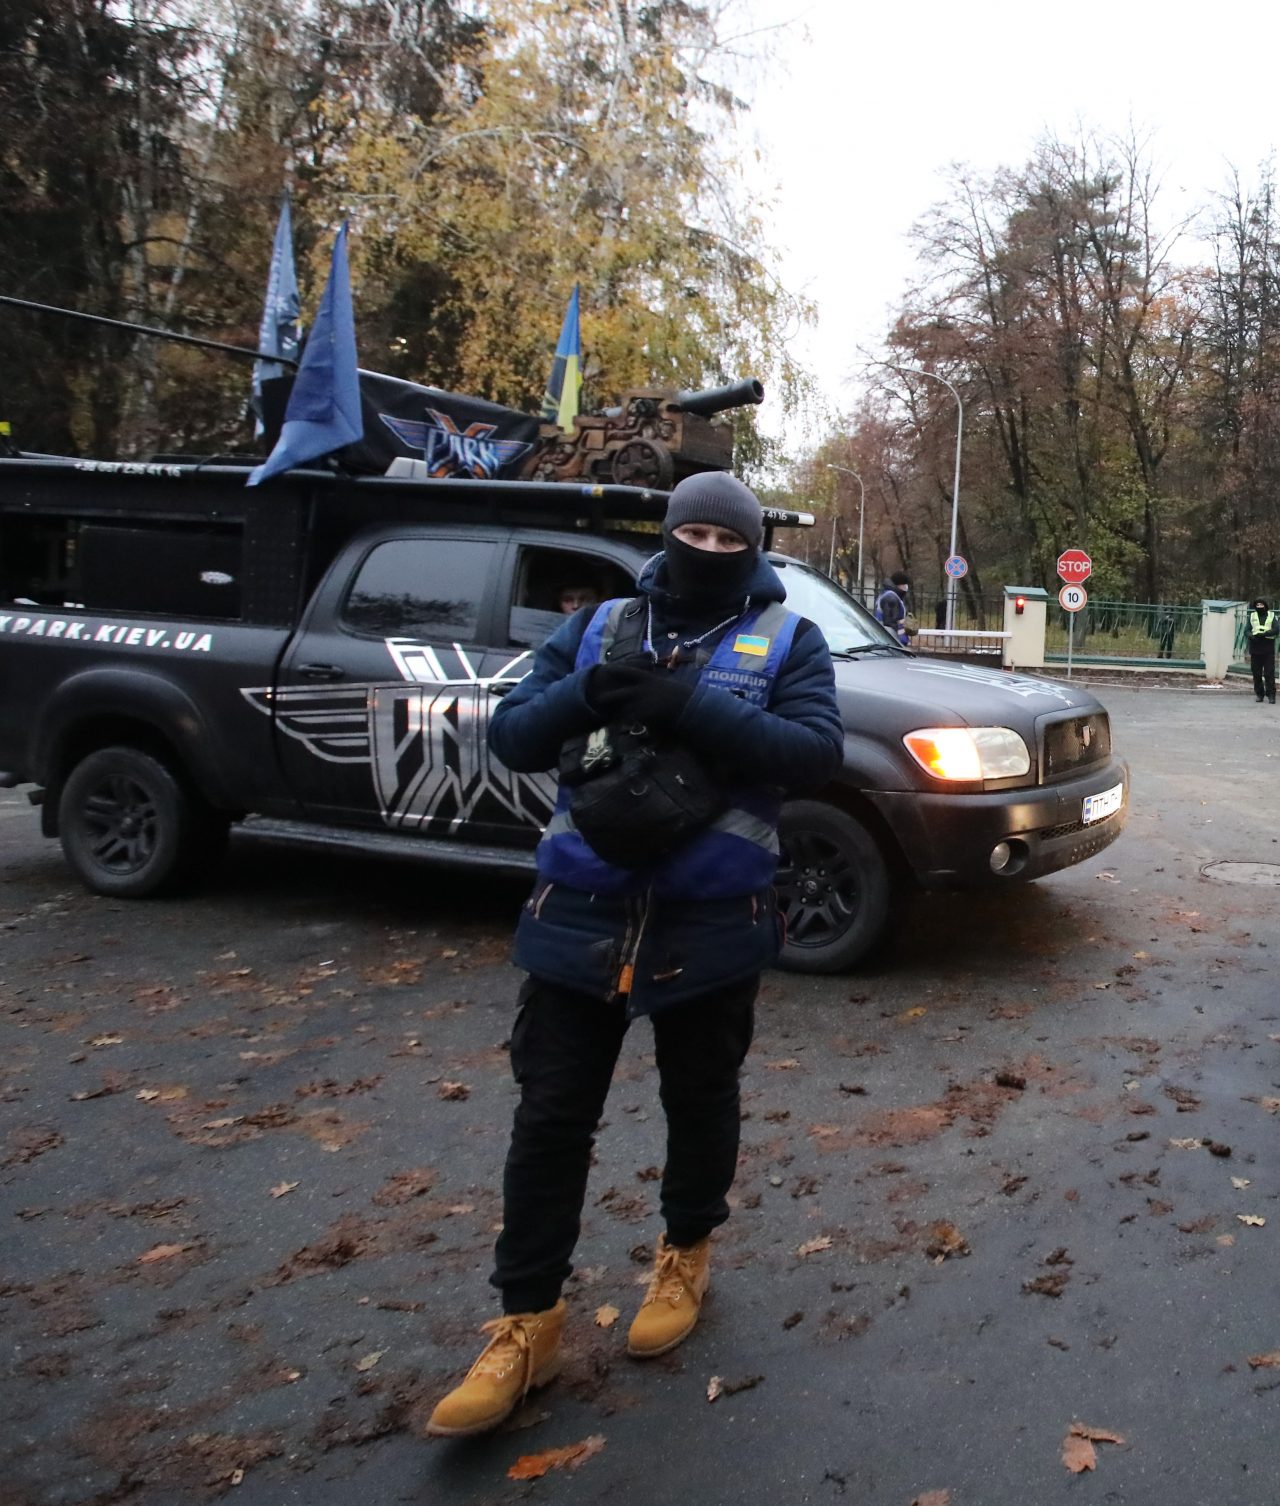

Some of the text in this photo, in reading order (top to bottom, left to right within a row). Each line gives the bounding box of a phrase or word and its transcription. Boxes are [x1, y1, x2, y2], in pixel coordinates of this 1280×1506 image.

[1059, 560, 1090, 572] STOP
[1068, 592, 1079, 603] 10
[708, 670, 767, 687] ПОЛІЦІЯ
